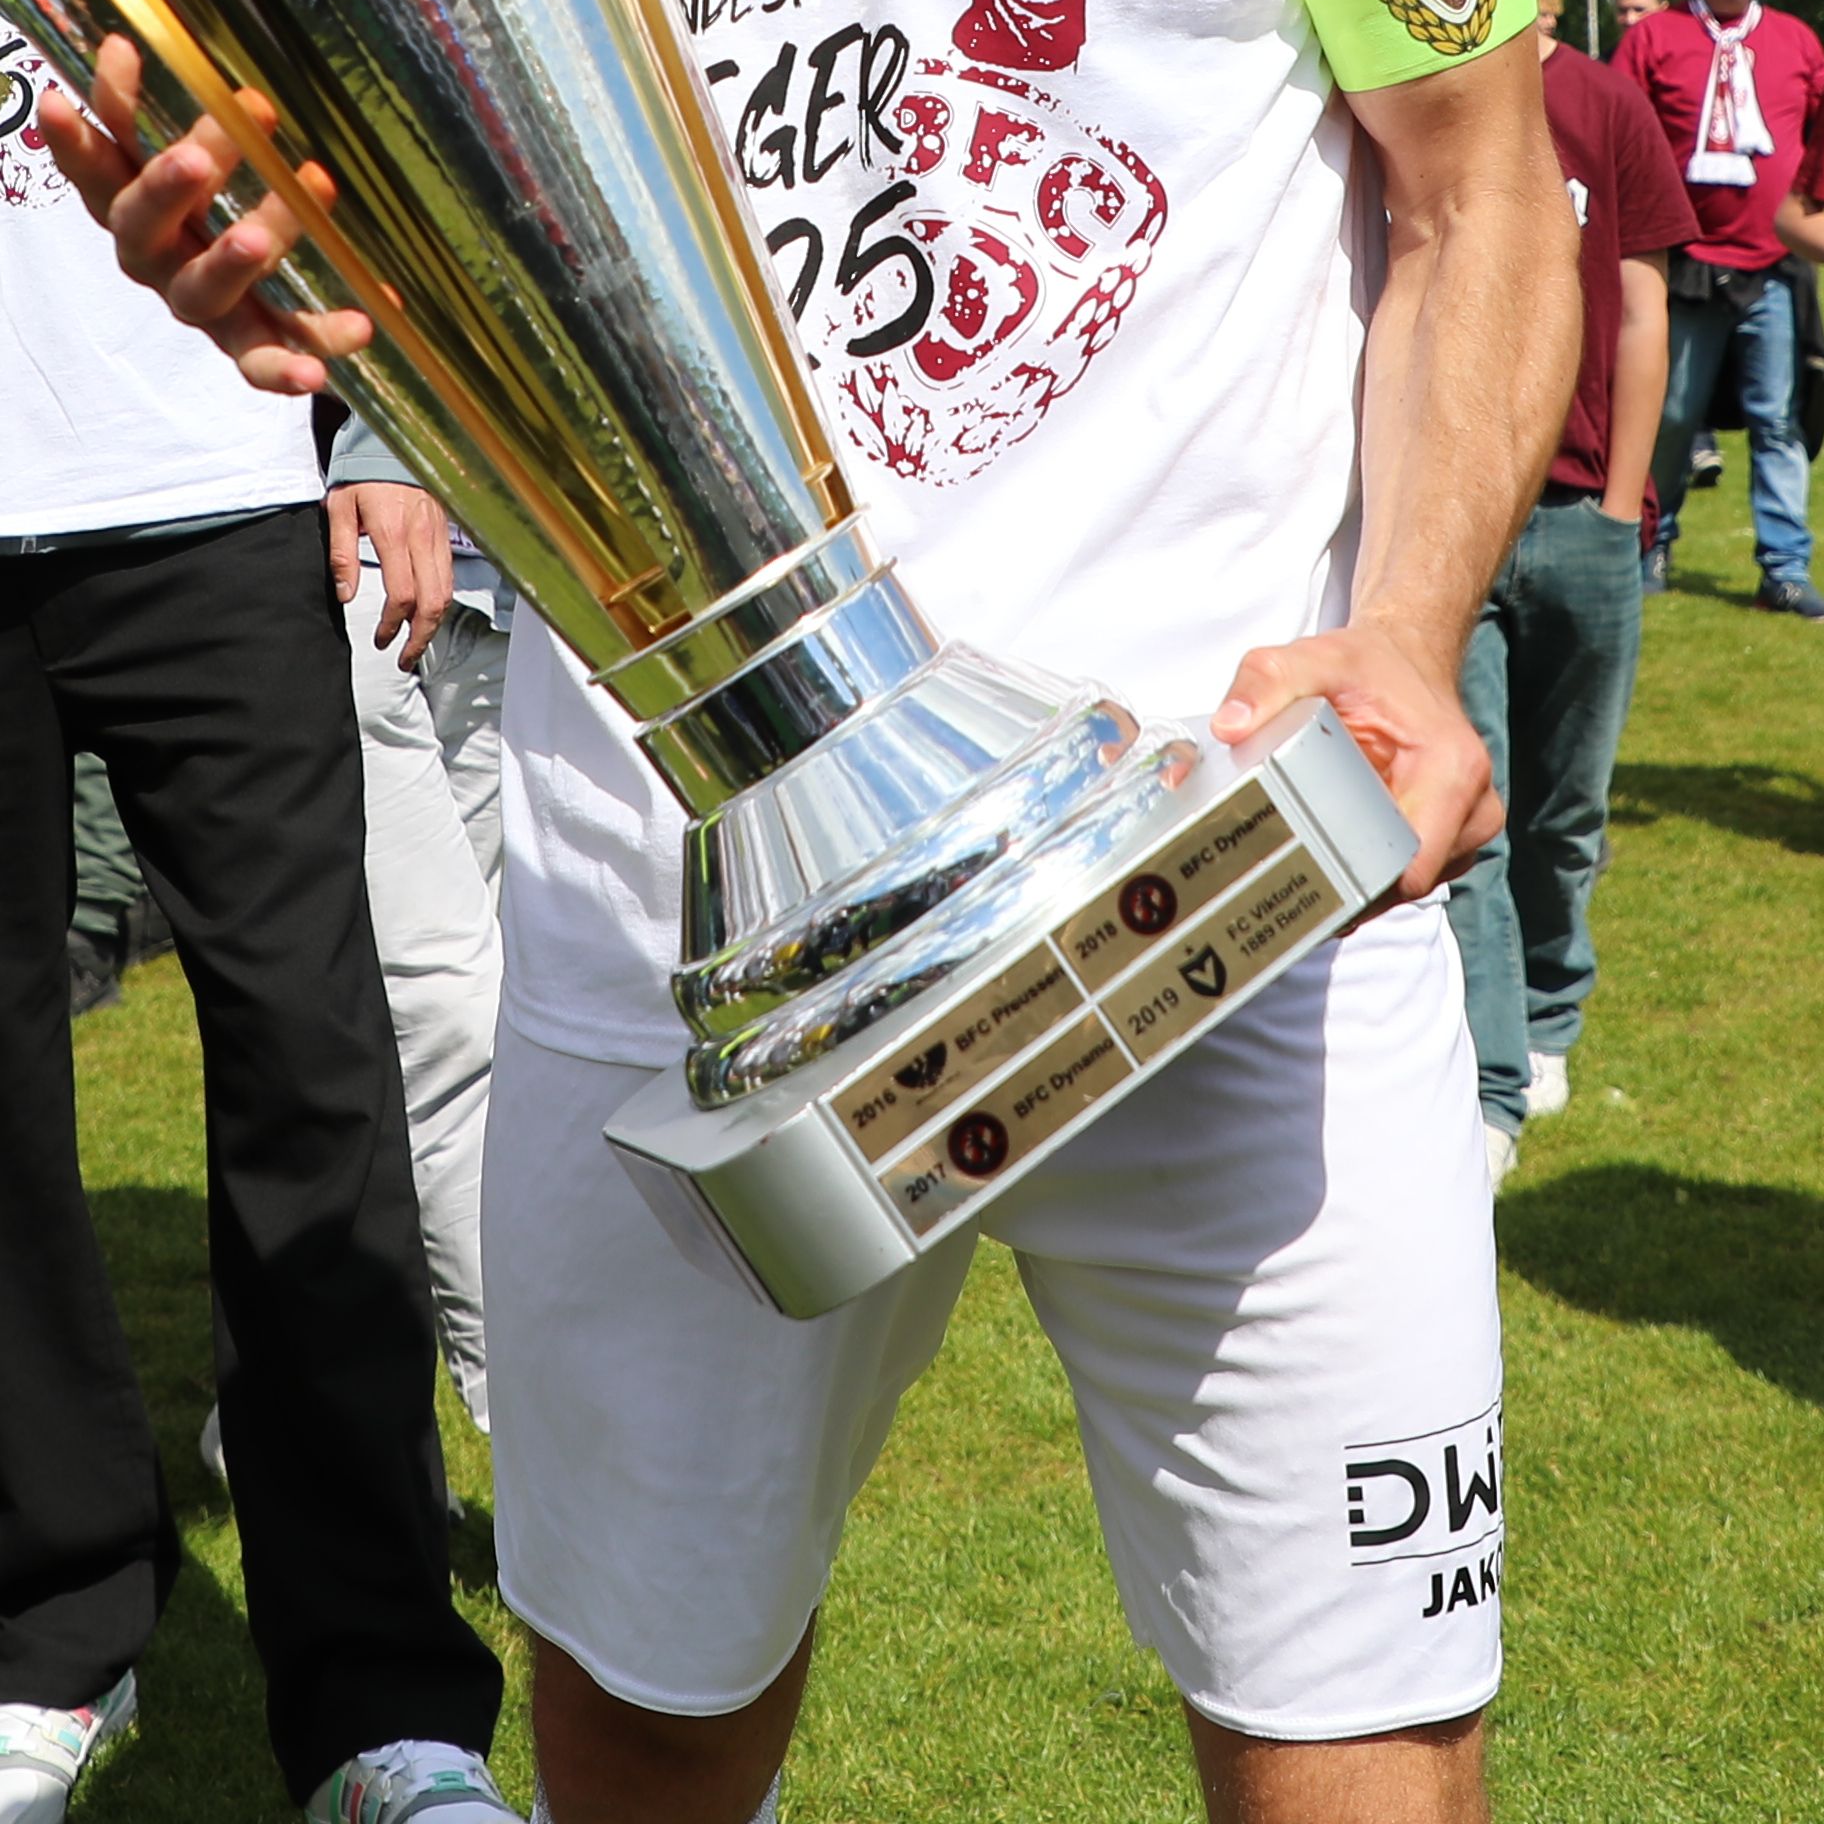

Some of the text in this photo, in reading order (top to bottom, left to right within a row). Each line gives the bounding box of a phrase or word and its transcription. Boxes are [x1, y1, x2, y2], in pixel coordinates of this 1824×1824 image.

[705, 23, 910, 190] GER
[1075, 801, 1277, 960] 2018 BFC Dynamo
[1226, 873, 1309, 942] FC Viktoria
[1240, 890, 1322, 958] 1889 Berlin
[852, 965, 1066, 1127] 2016 BFC Preussen
[1128, 987, 1181, 1036] 2019
[905, 1037, 1116, 1203] 2017 BFC Dynamo
[1345, 1422, 1502, 1548] DW
